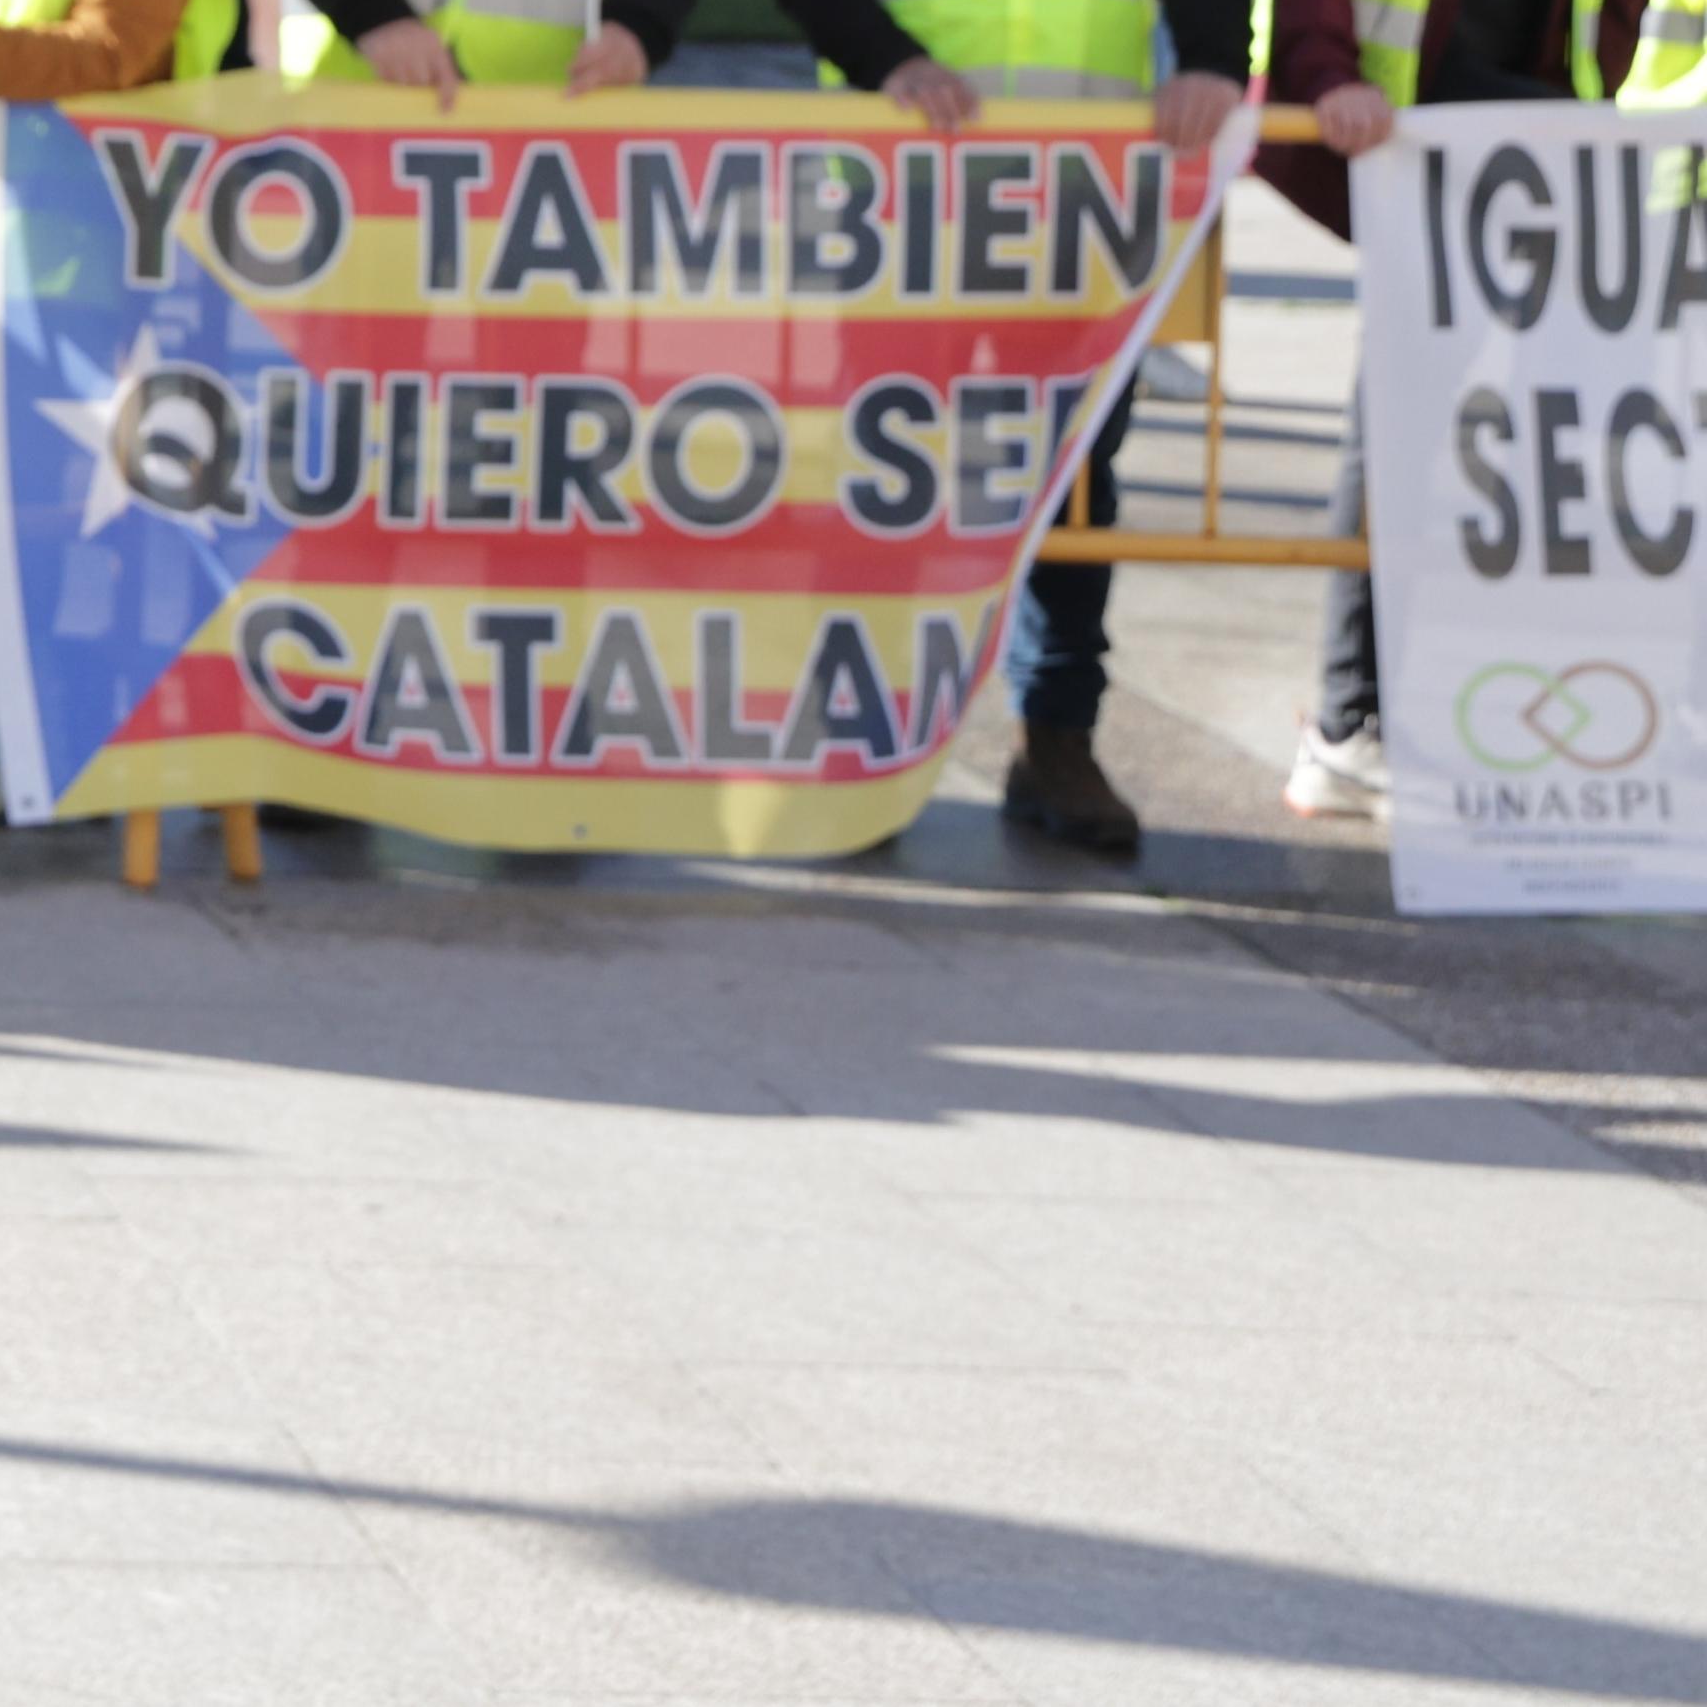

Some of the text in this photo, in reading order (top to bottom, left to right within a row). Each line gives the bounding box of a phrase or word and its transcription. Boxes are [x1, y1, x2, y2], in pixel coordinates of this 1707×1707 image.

[98, 130, 1172, 297] YO TAMBIEN
[112, 364, 784, 533] QUIERO
[1452, 779, 1674, 823] UNASPI
